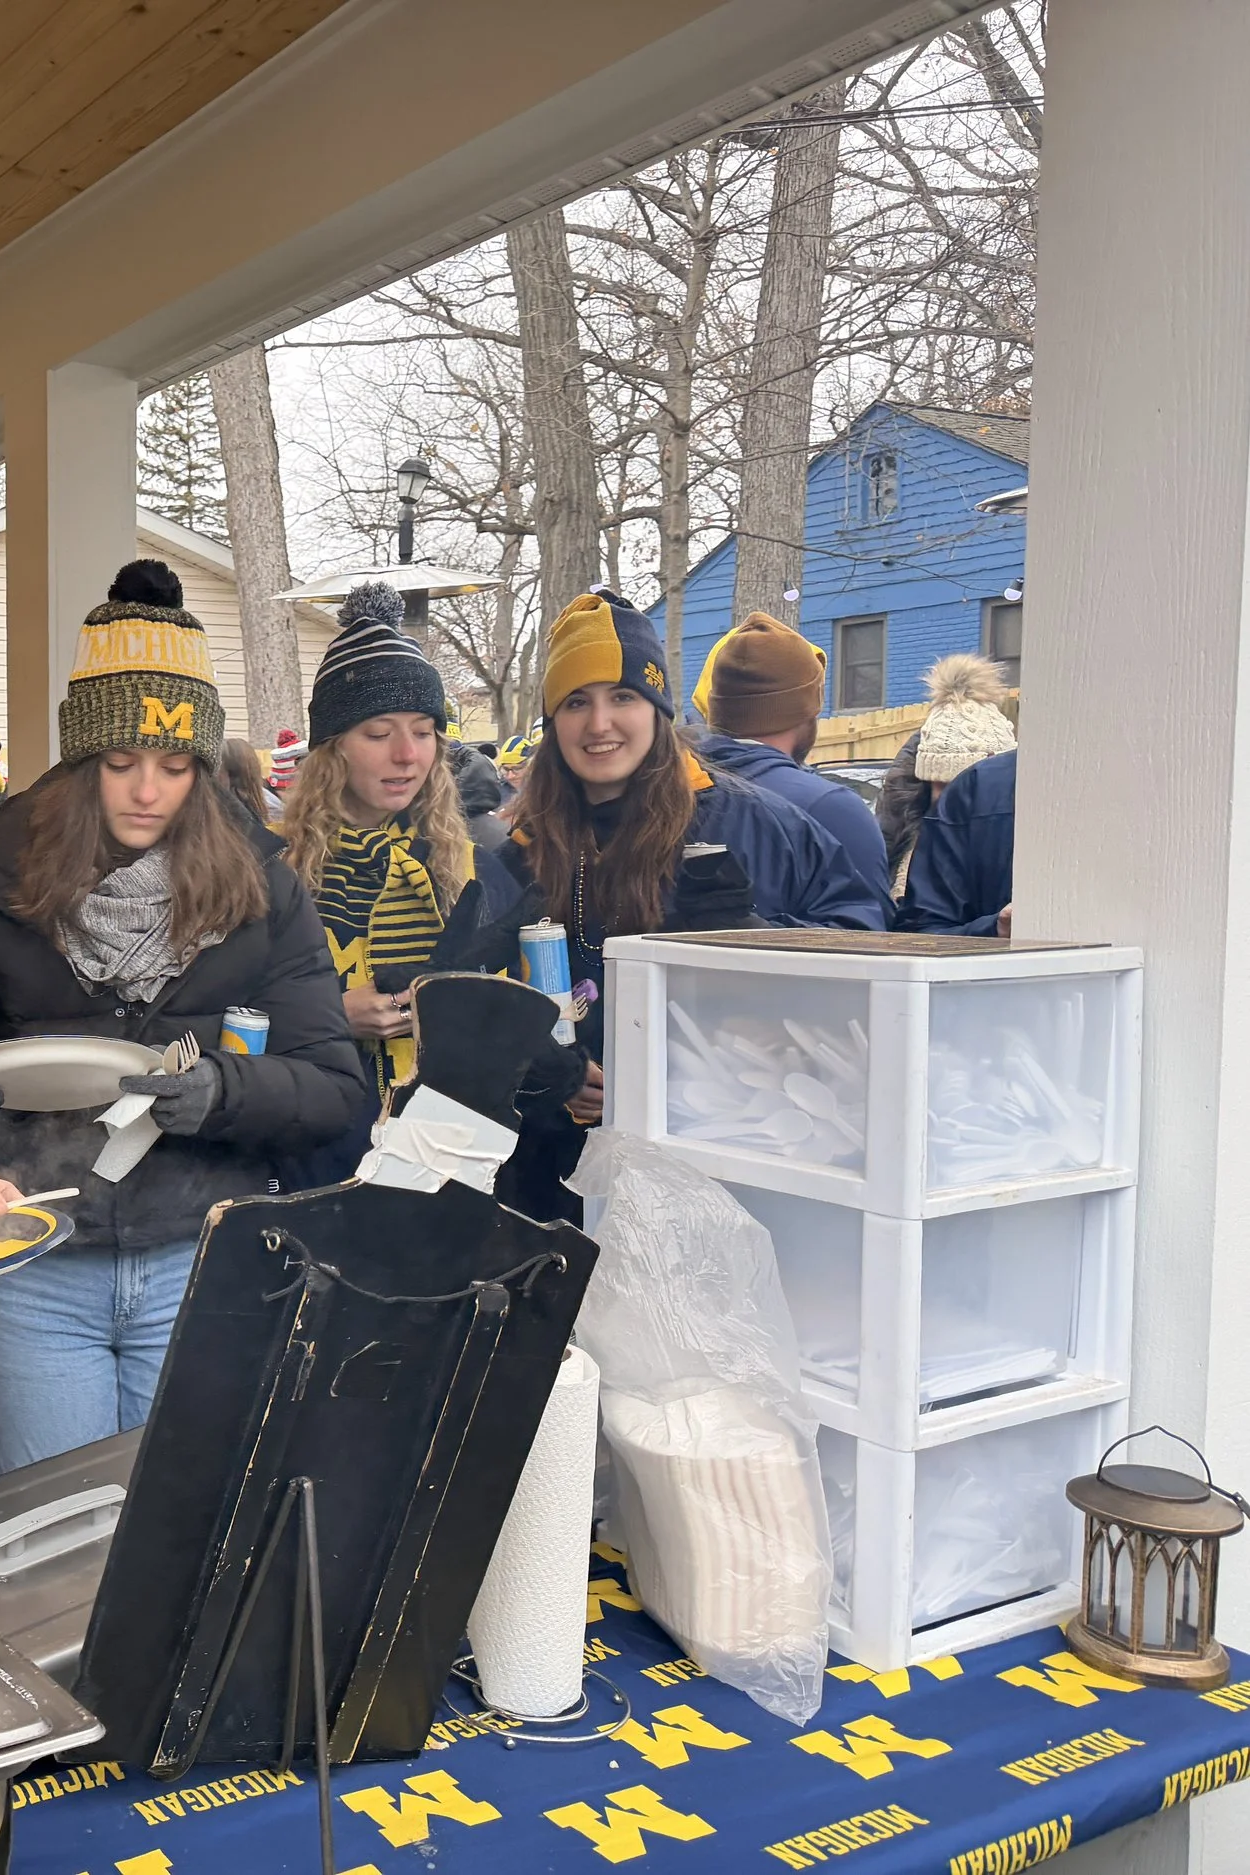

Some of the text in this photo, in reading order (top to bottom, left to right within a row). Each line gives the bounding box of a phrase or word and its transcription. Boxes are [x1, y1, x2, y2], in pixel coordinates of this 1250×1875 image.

[138, 696, 195, 740] M
[596, 1704, 751, 1769] M
[789, 1714, 954, 1780] M
[999, 1728, 1146, 1785] MICHIGAN
[133, 1768, 305, 1826] MICHIGAN
[339, 1769, 503, 1848] M
[1161, 1747, 1250, 1809] ICHIGAN
[543, 1784, 717, 1864] M
[764, 1804, 931, 1870] MICHIGAN
